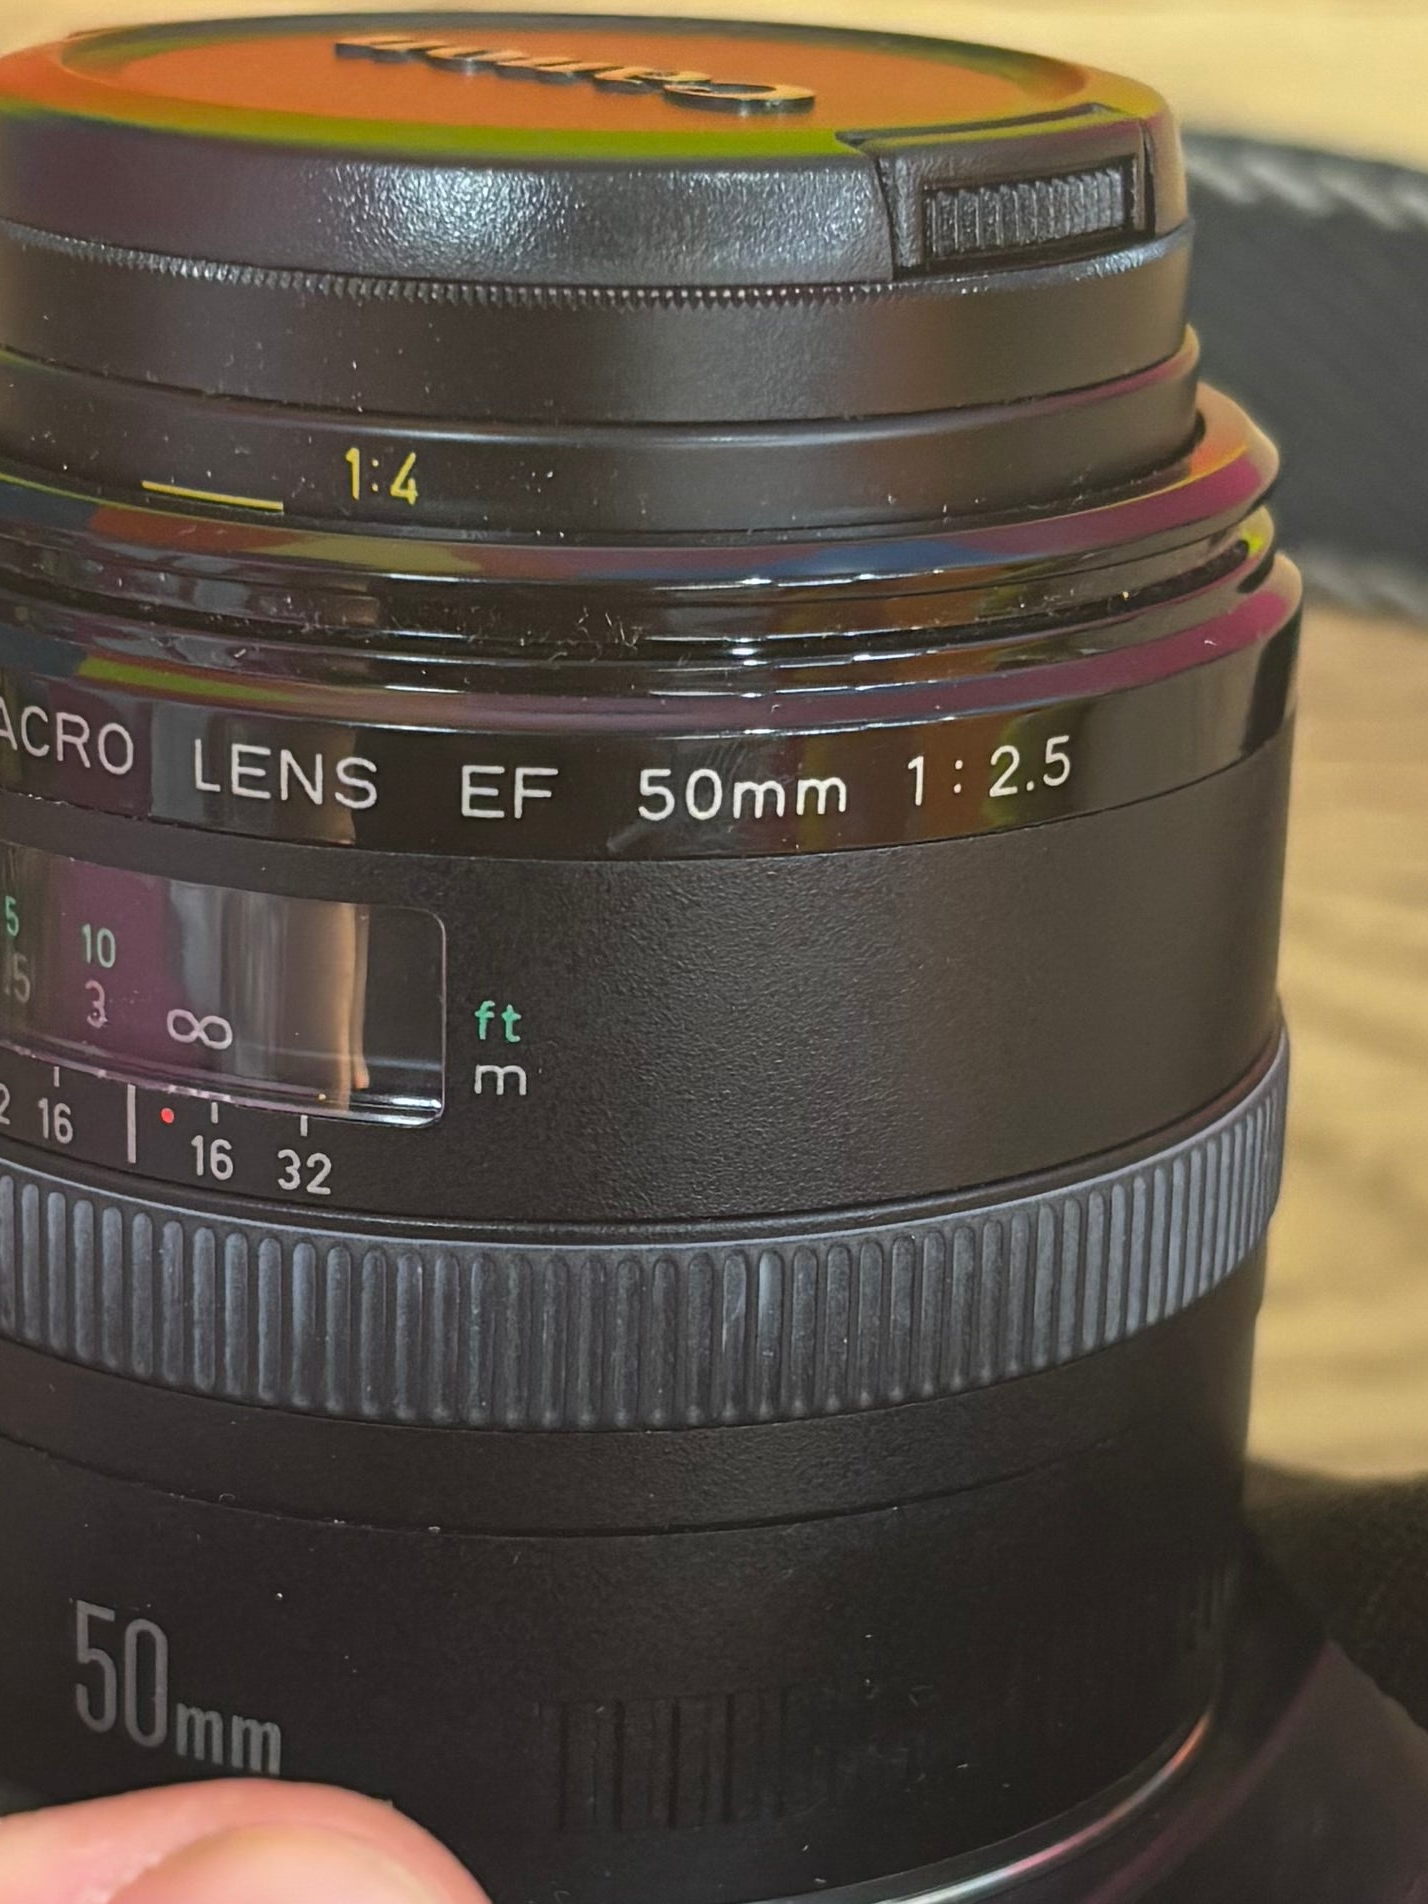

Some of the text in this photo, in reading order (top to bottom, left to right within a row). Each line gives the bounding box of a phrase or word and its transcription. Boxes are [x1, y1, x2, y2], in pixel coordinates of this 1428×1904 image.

[345, 447, 418, 505] 1:4
[193, 738, 379, 810] LENS
[461, 763, 559, 821] EF
[638, 768, 847, 822] 50mm
[4, 895, 117, 970] 5 10
[83, 980, 107, 1030] 3
[474, 1000, 523, 1044] ft
[474, 1063, 527, 1096] m
[37, 1096, 73, 1145] 16
[191, 1134, 234, 1181] 16
[276, 1147, 332, 1196] 32
[74, 1598, 283, 1776] 50mm
